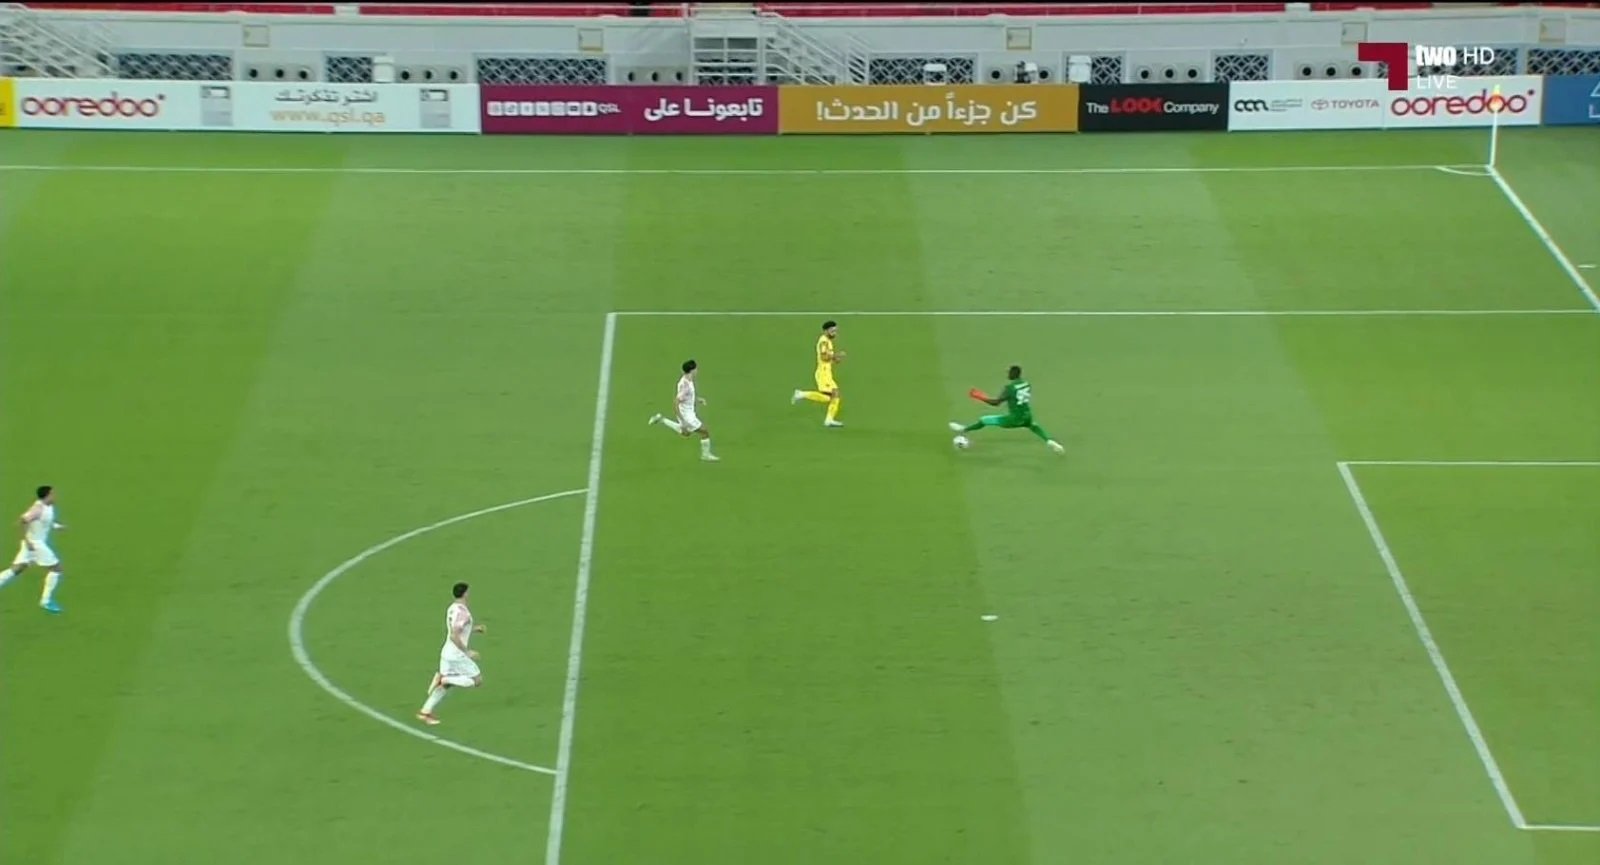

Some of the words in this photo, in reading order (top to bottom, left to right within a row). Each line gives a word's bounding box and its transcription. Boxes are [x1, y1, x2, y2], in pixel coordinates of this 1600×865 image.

[21, 91, 160, 117] ooredoo
[598, 103, 621, 114] QSL
[644, 98, 680, 121] على
[684, 97, 763, 122] تابعونا
[816, 99, 898, 121] الحدث!
[906, 102, 942, 126] من
[1000, 101, 1037, 125] كن
[1086, 102, 1109, 113] The
[1110, 98, 1163, 113] LOOK
[1163, 101, 1219, 115] Company
[1332, 99, 1379, 109] TOYOTA
[1391, 89, 1527, 116] ooredoo
[270, 109, 386, 126] www.qsl.qa
